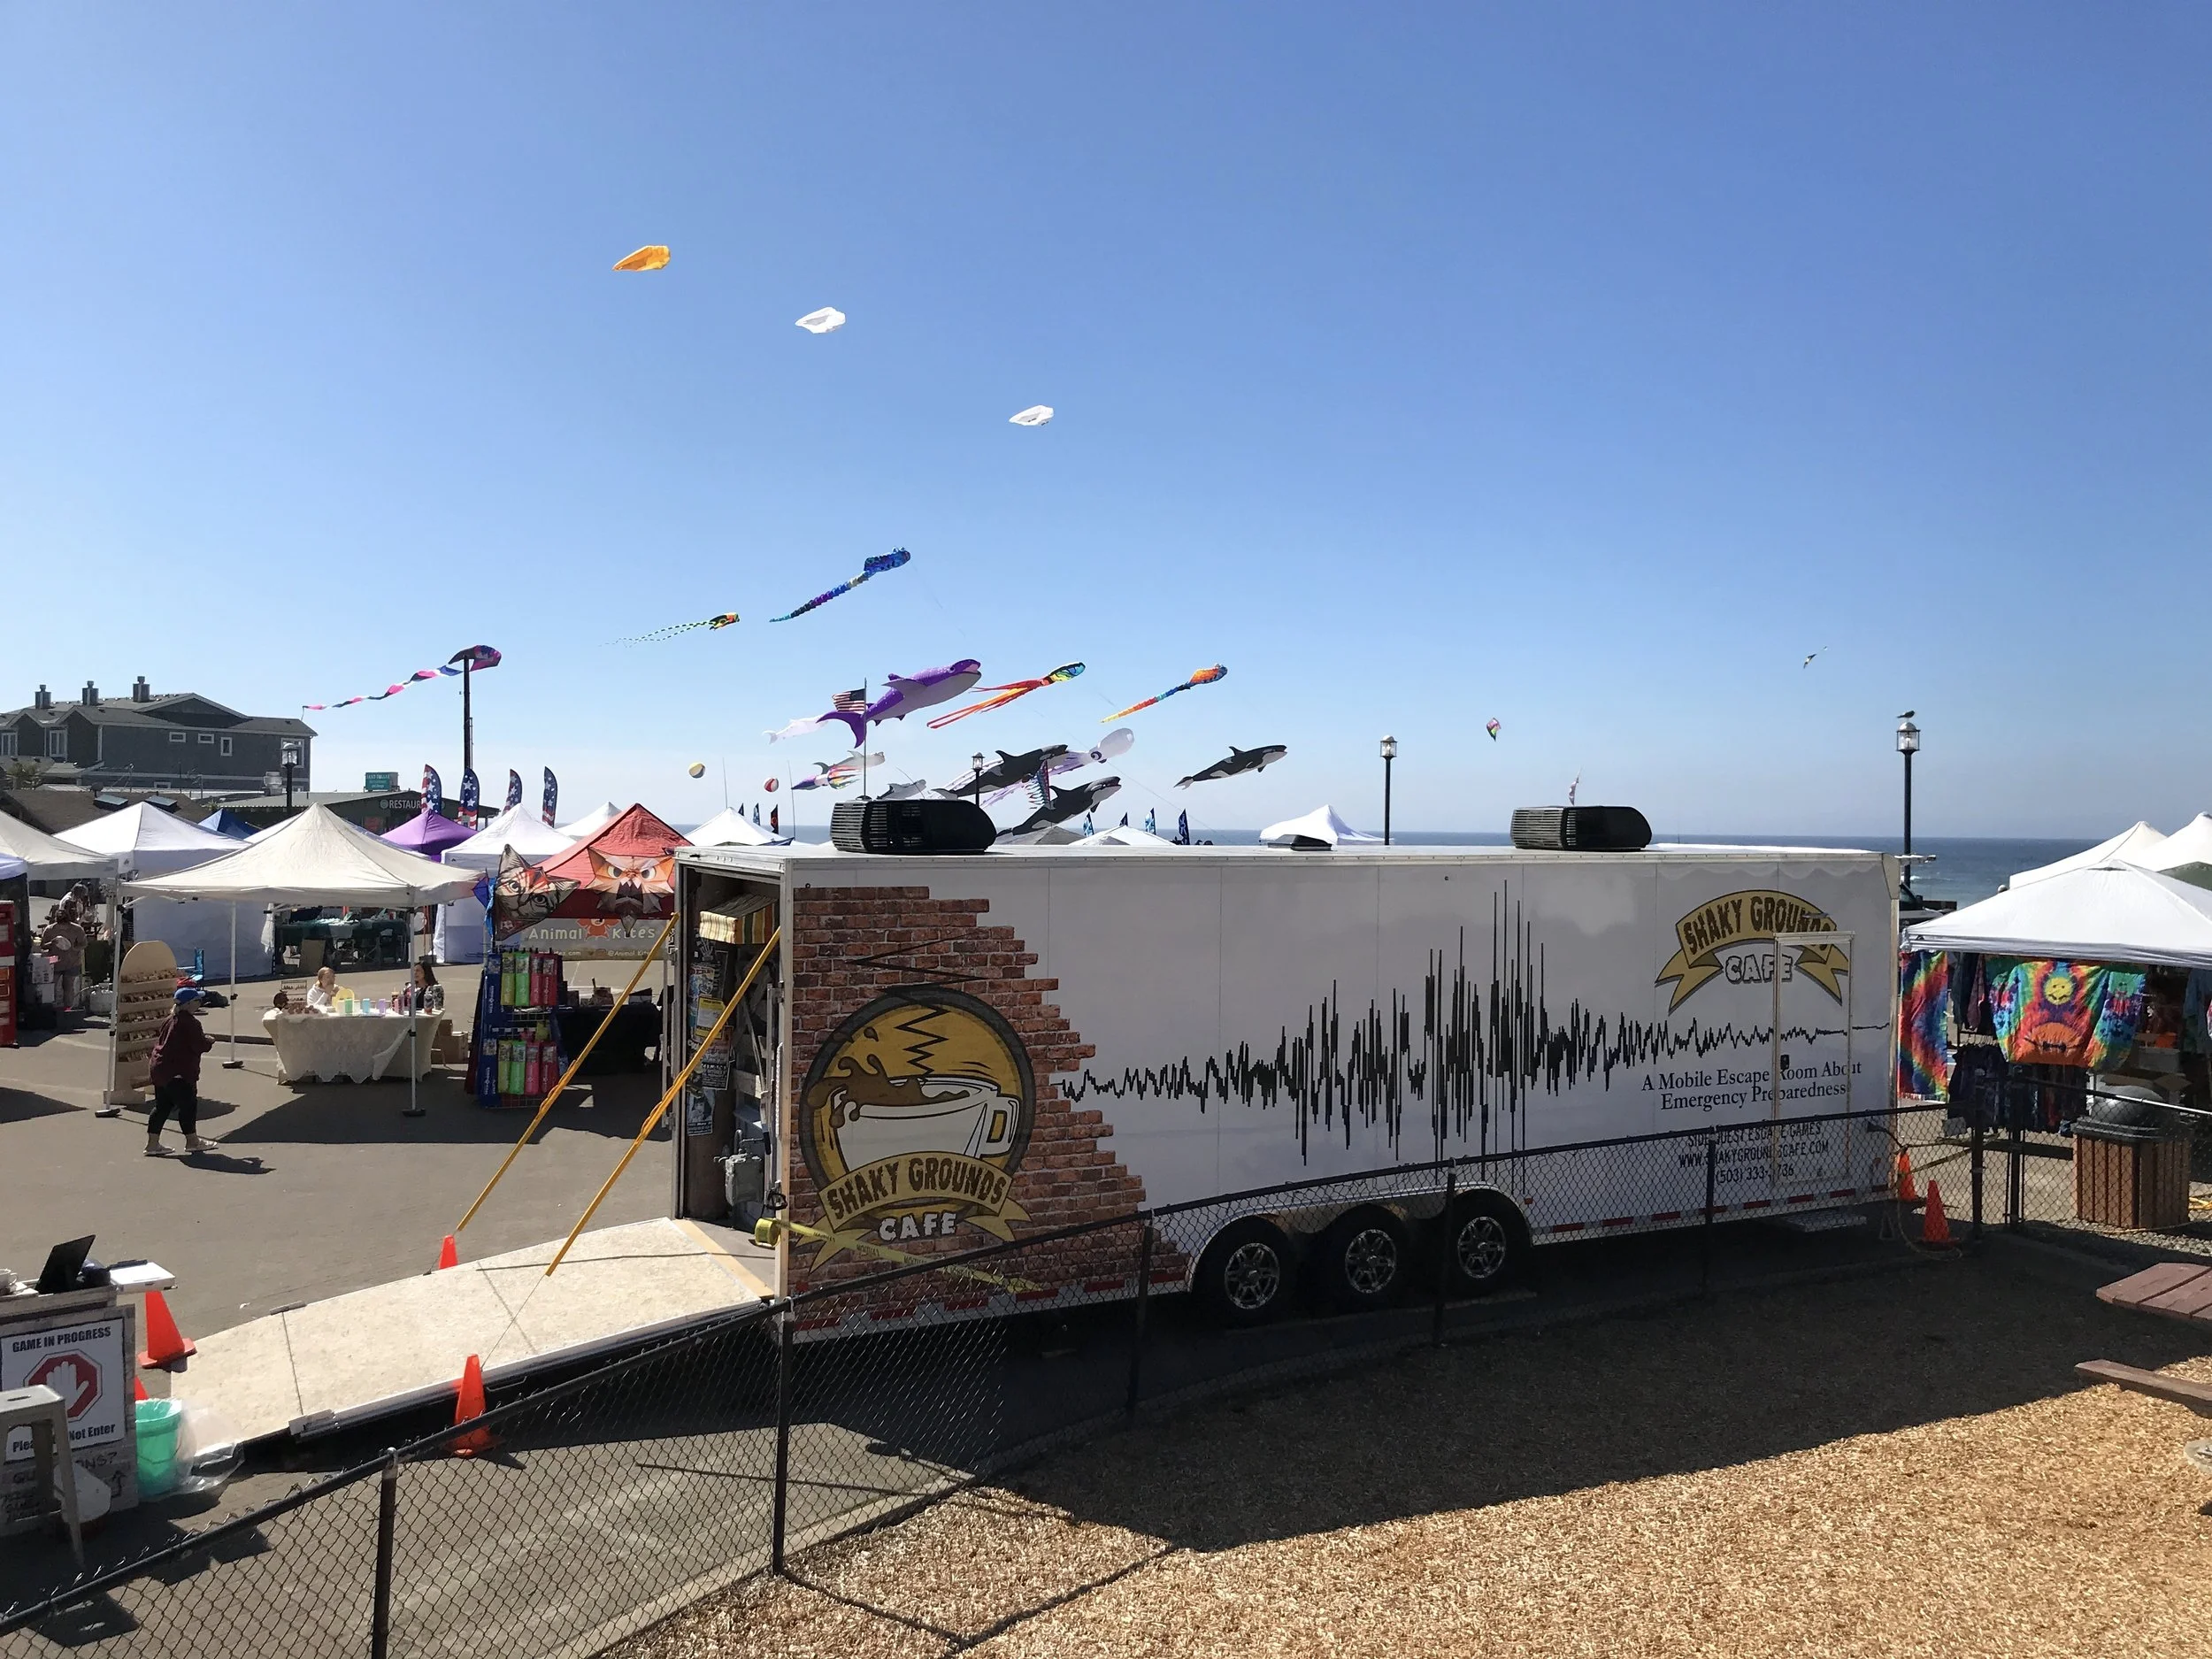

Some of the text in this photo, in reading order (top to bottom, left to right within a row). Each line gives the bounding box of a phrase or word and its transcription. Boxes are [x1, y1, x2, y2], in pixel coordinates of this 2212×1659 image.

[389, 800, 422, 809] RESTAUR
[528, 928, 582, 940] Animal
[1683, 898, 1743, 956] SHAKY
[1724, 954, 1793, 984] CAFE
[1641, 1074, 1655, 1091] A
[1658, 1071, 1713, 1090] Mobile
[1716, 1068, 1770, 1087] Escape
[1661, 1081, 1847, 1112] Emergency Preparedness
[1747, 1125, 1786, 1141] ESCAE
[1789, 1122, 1822, 1138] GAMES
[826, 1157, 1008, 1219] SHAKY GROUNDS
[1716, 1168, 1743, 1186] (503)
[879, 1210, 956, 1241] CAFE
[12, 1326, 111, 1353] GAME IN PROGRESS
[12, 1424, 116, 1453] Ple Not Enter
